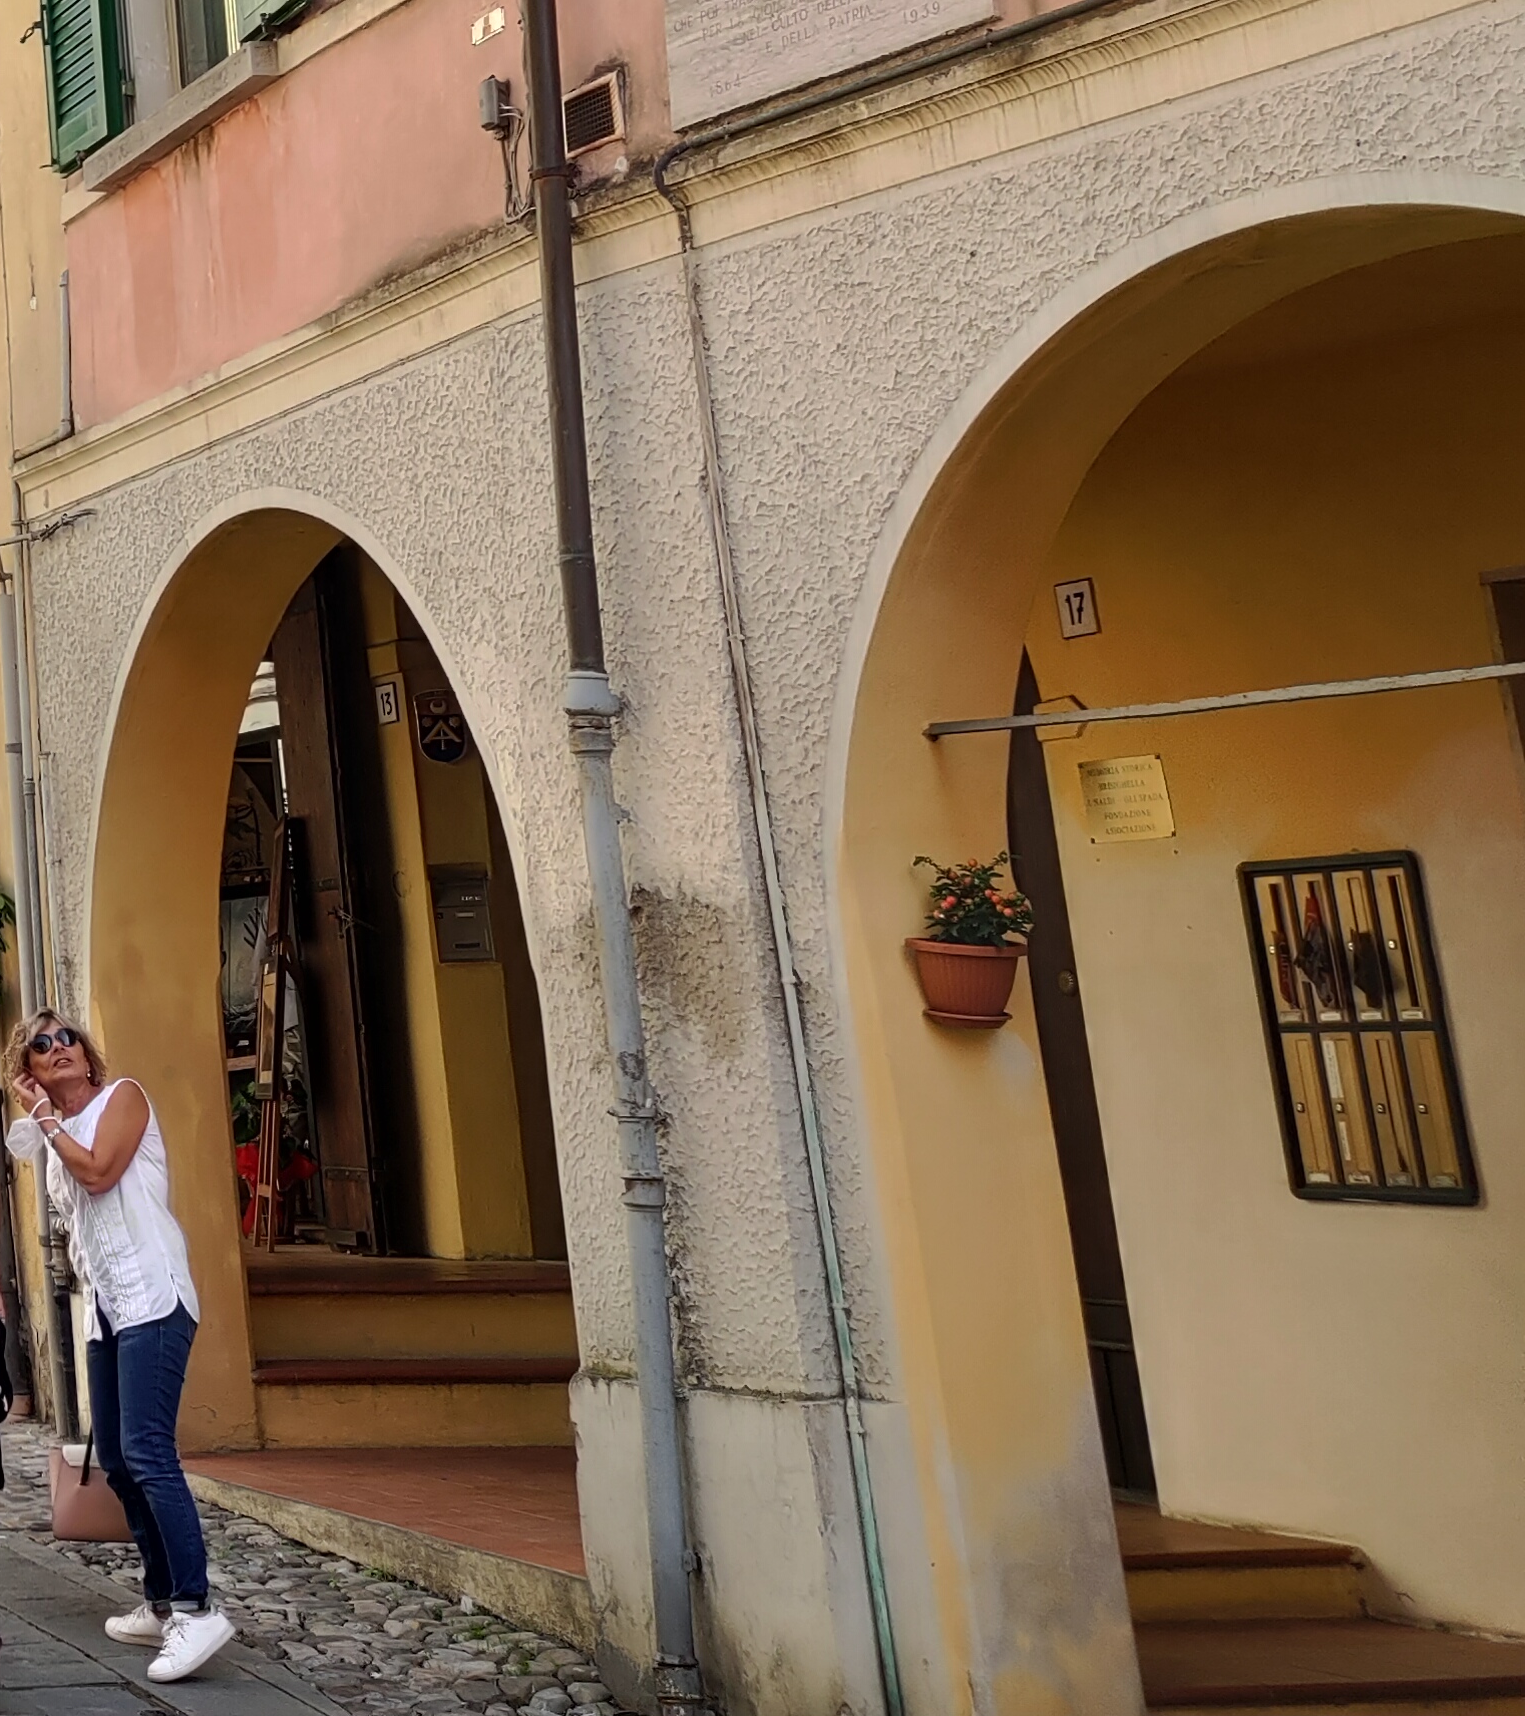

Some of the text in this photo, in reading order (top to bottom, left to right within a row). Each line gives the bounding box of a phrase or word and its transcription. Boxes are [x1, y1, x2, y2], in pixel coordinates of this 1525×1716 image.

[673, 14, 693, 33] CHE
[771, 7, 808, 33] CULTO
[781, 22, 819, 48] DELLA
[828, 2, 872, 31] PATRIA
[1065, 592, 1085, 626] 17
[380, 692, 393, 716] 13
[1104, 809, 1152, 820] FONDAZIONE
